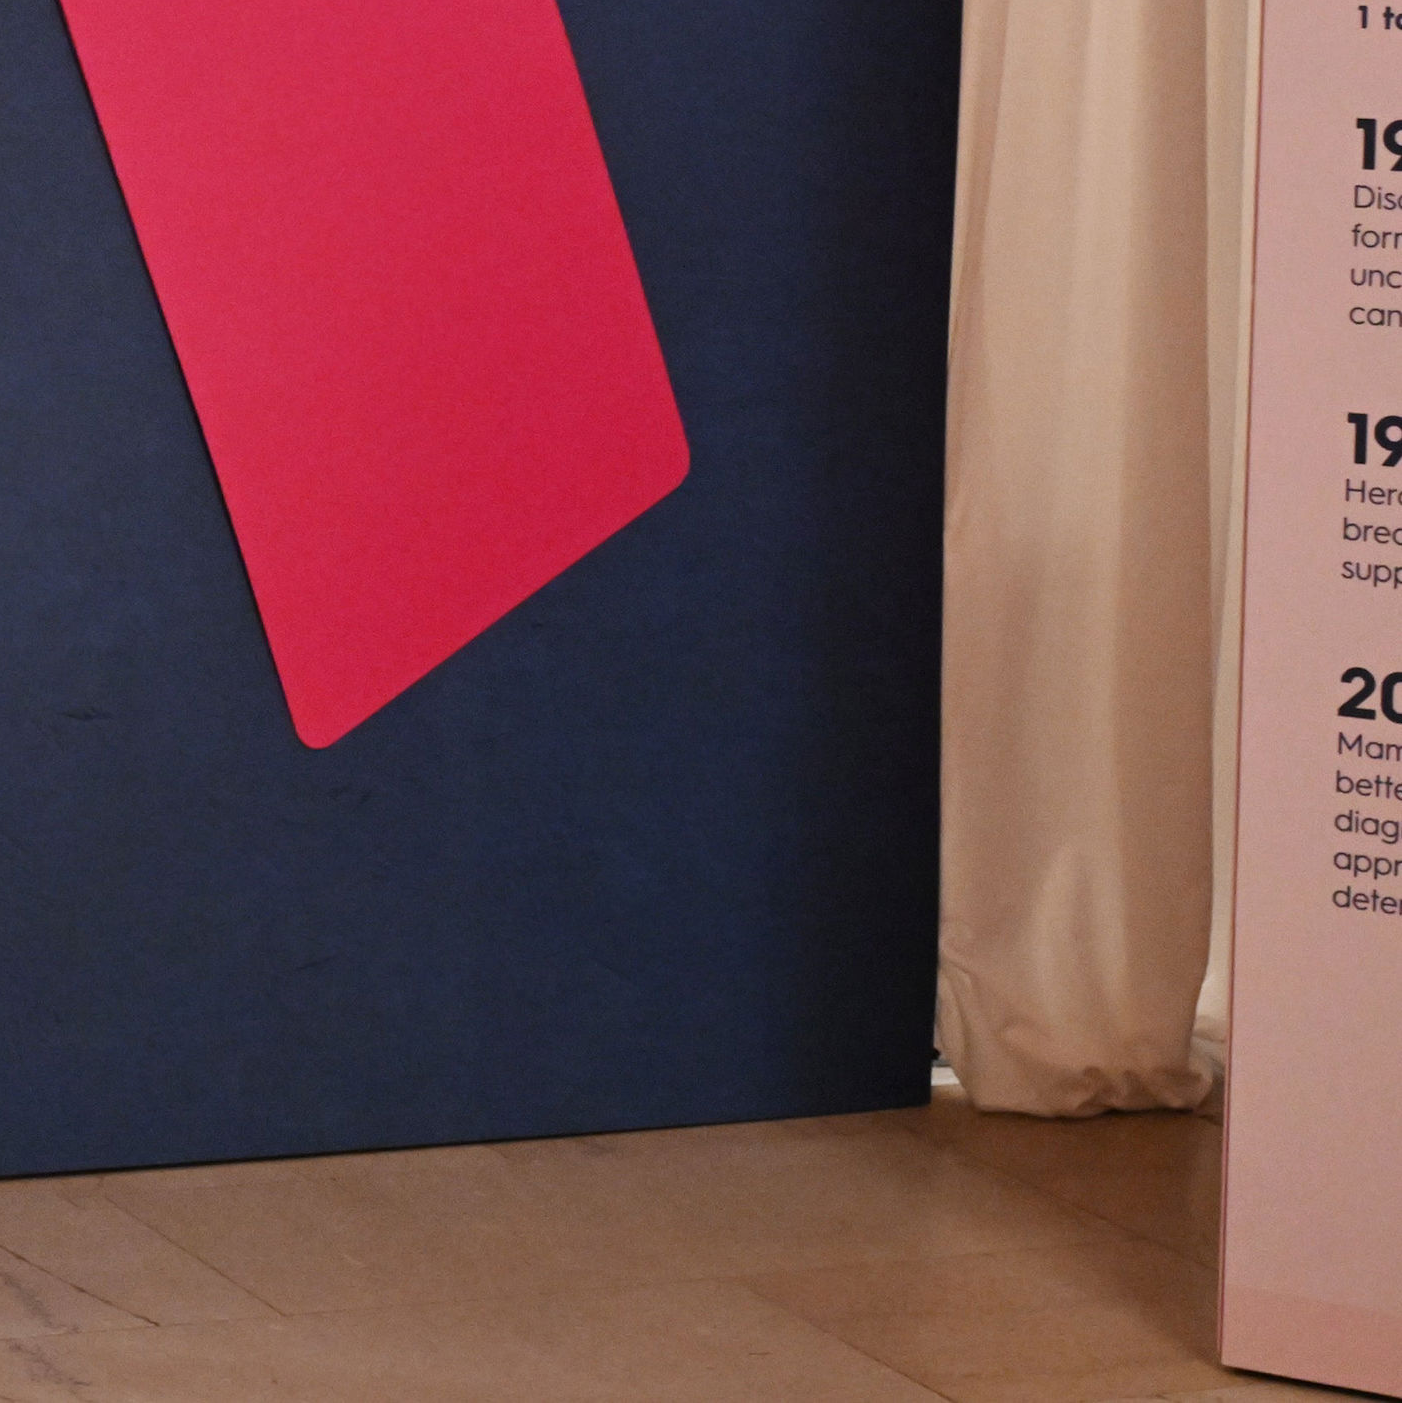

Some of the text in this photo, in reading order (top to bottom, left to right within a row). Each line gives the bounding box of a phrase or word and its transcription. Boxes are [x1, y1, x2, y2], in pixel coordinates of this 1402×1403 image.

[1358, 5, 1368, 29] 1
[1352, 223, 1402, 249] for
[1351, 269, 1402, 289] unc
[1347, 412, 1402, 467] 19
[1346, 479, 1402, 505] Her
[1334, 810, 1402, 844] diag
